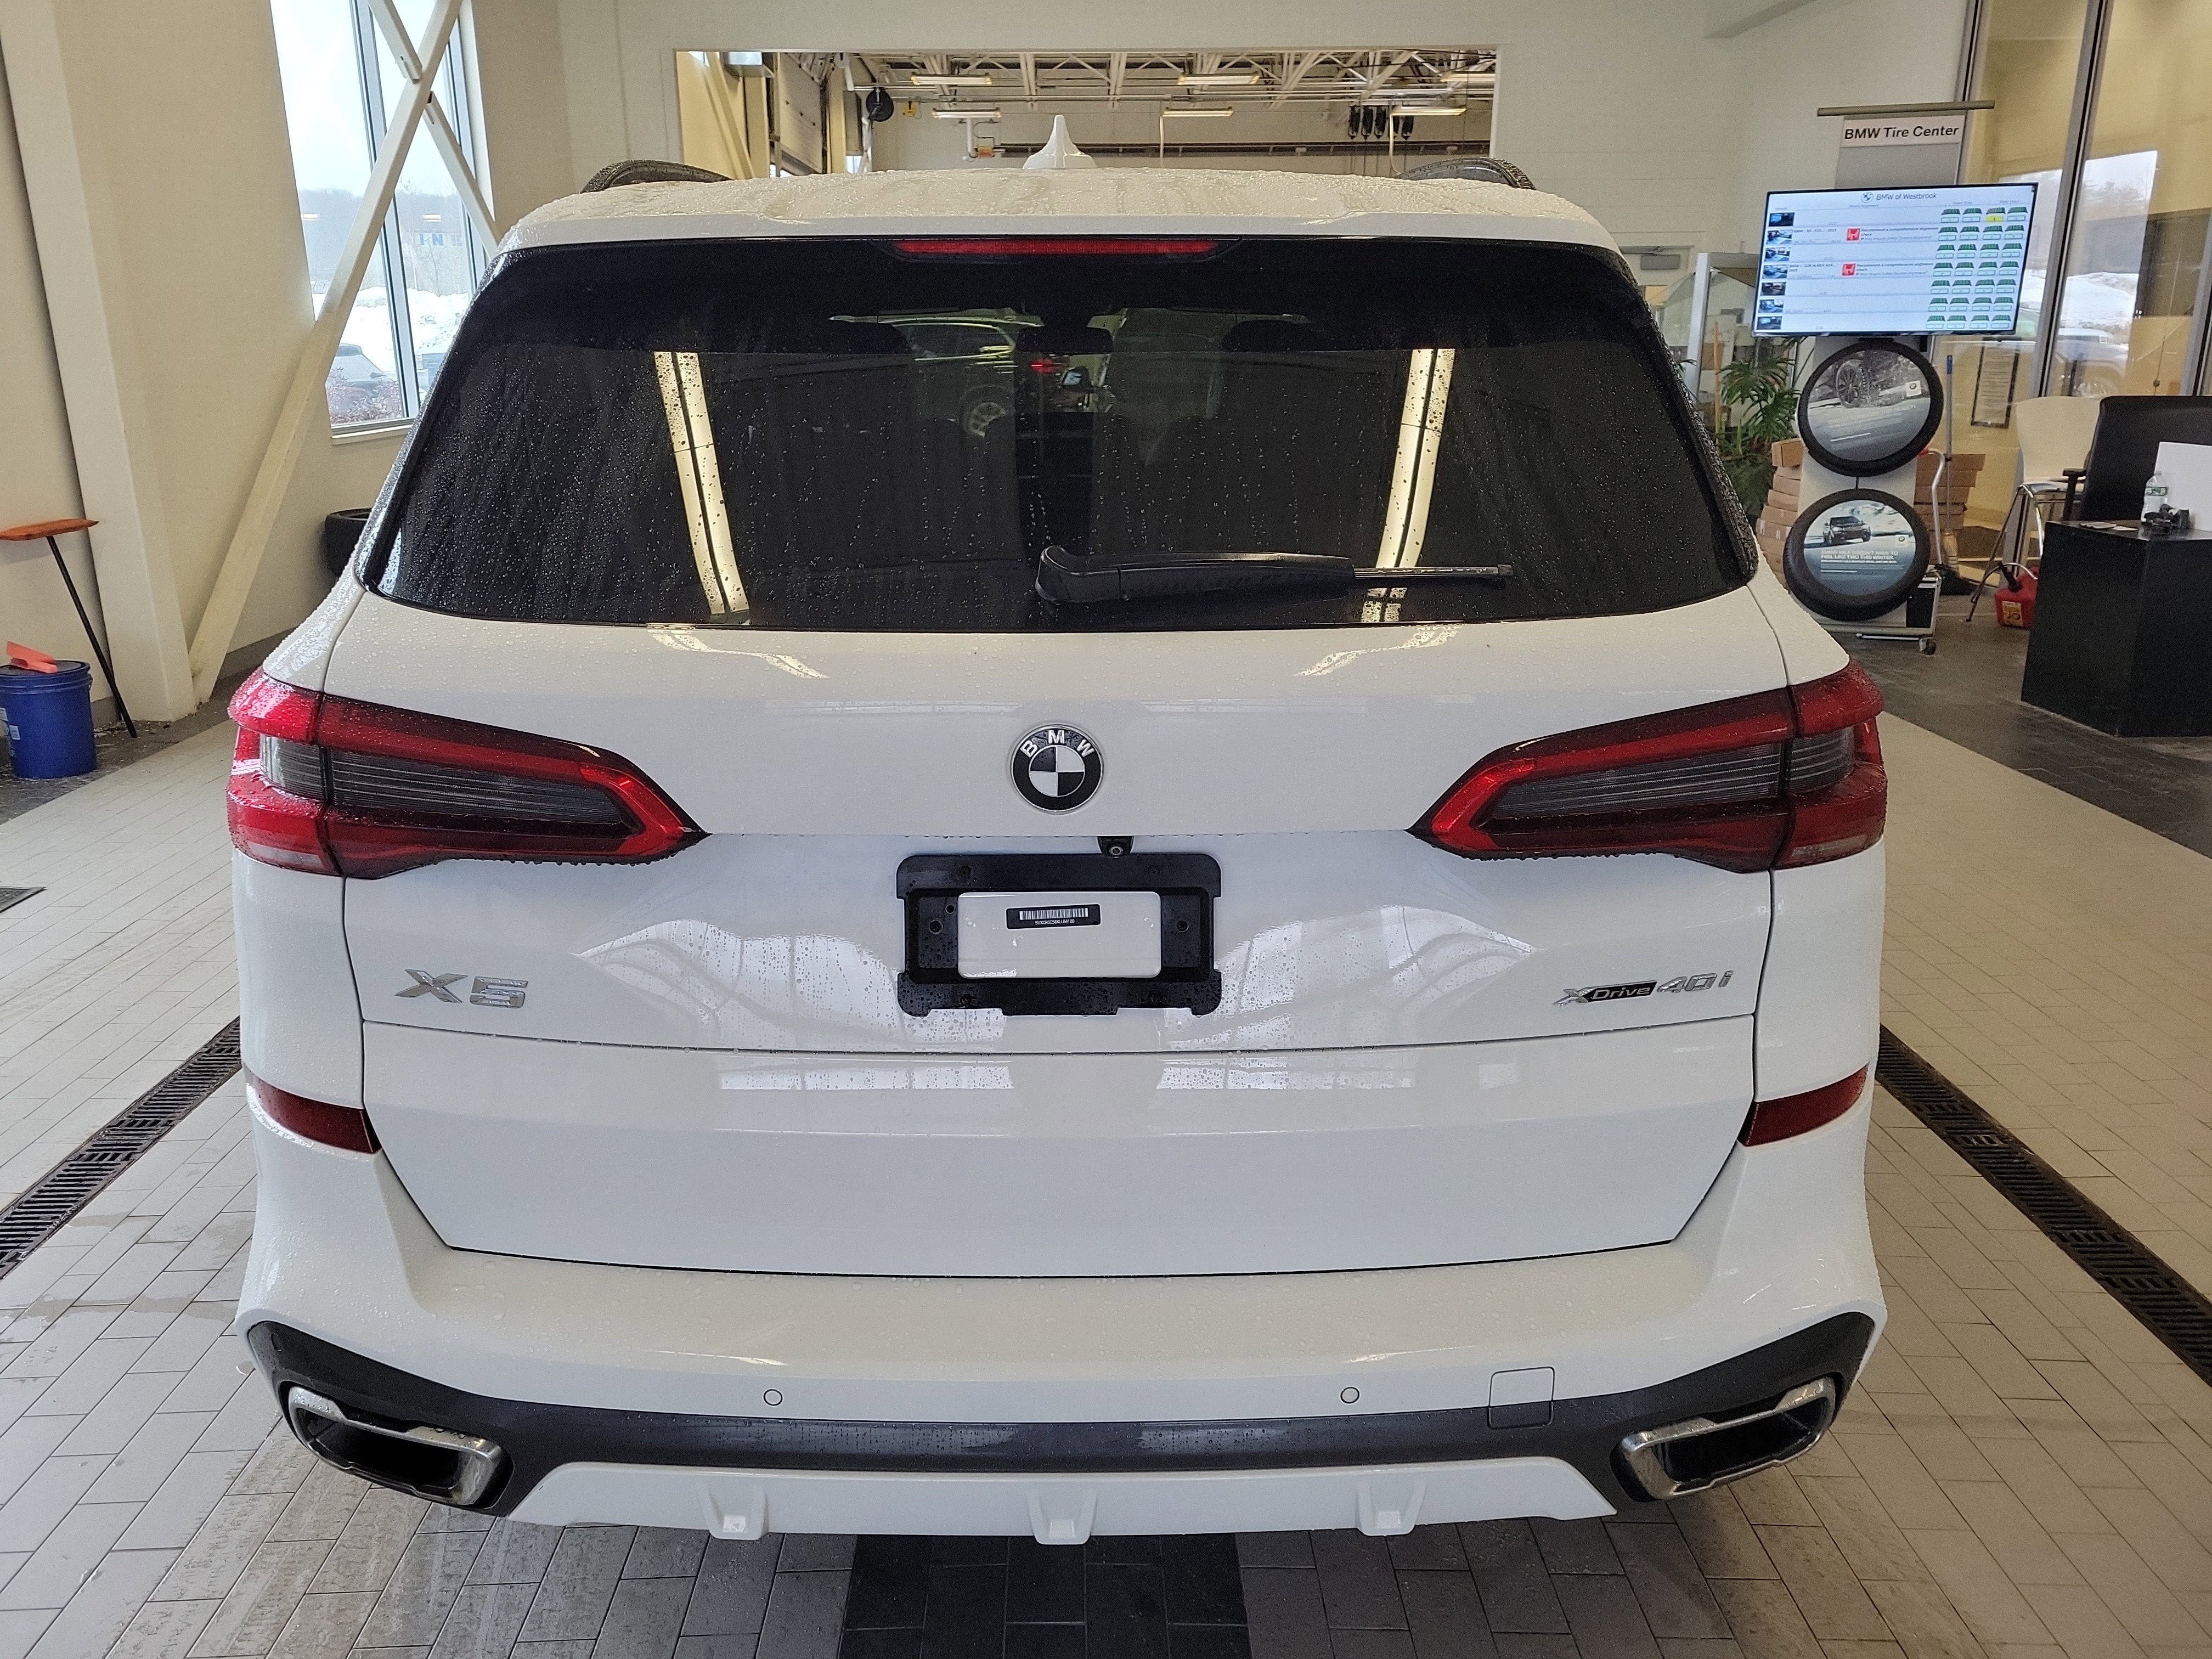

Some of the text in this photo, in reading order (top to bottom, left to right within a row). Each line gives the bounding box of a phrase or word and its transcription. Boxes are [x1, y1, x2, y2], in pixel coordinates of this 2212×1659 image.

[1844, 126, 1960, 140] BMW Tire Center
[1019, 730, 1095, 758] BMW
[394, 968, 528, 1009] X5
